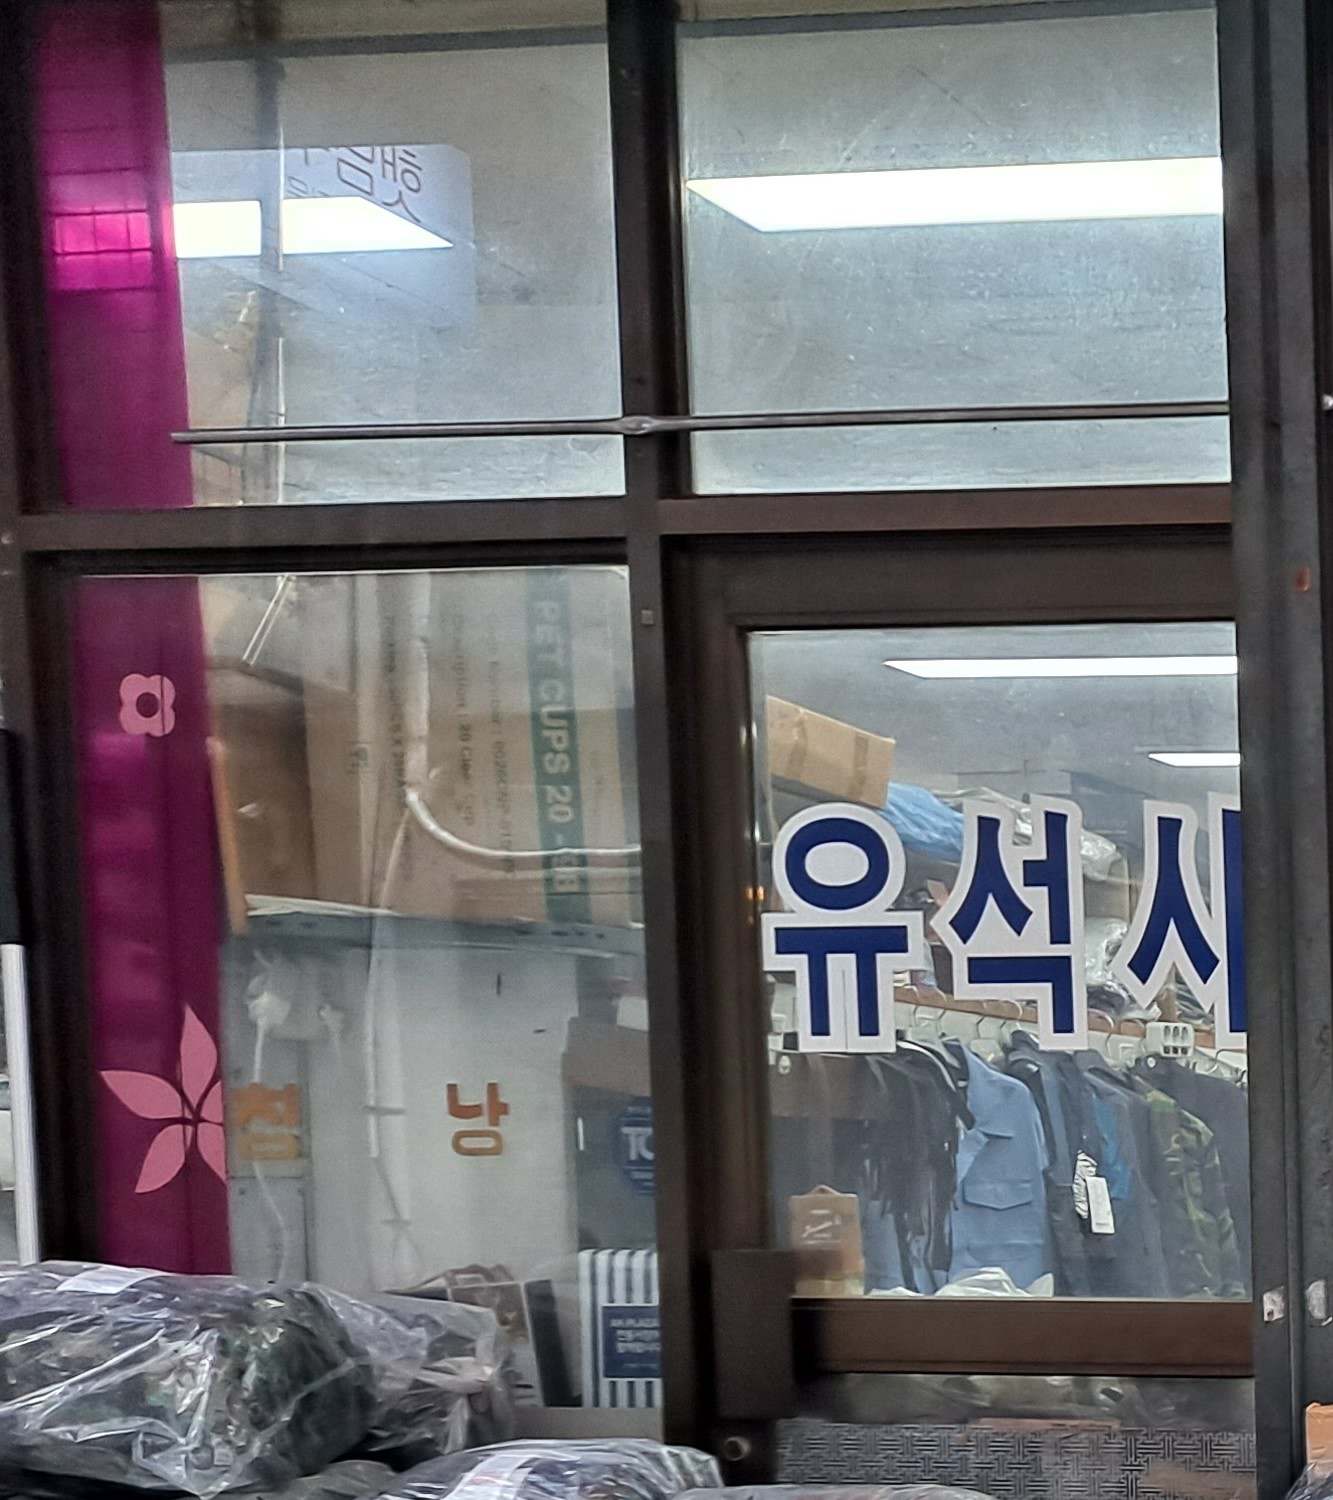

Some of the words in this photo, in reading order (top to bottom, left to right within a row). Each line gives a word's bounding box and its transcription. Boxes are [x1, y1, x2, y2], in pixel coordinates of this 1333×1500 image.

[539, 678, 572, 776] CUPS
[545, 785, 575, 824] 20
[767, 798, 1246, 1046] 유석사
